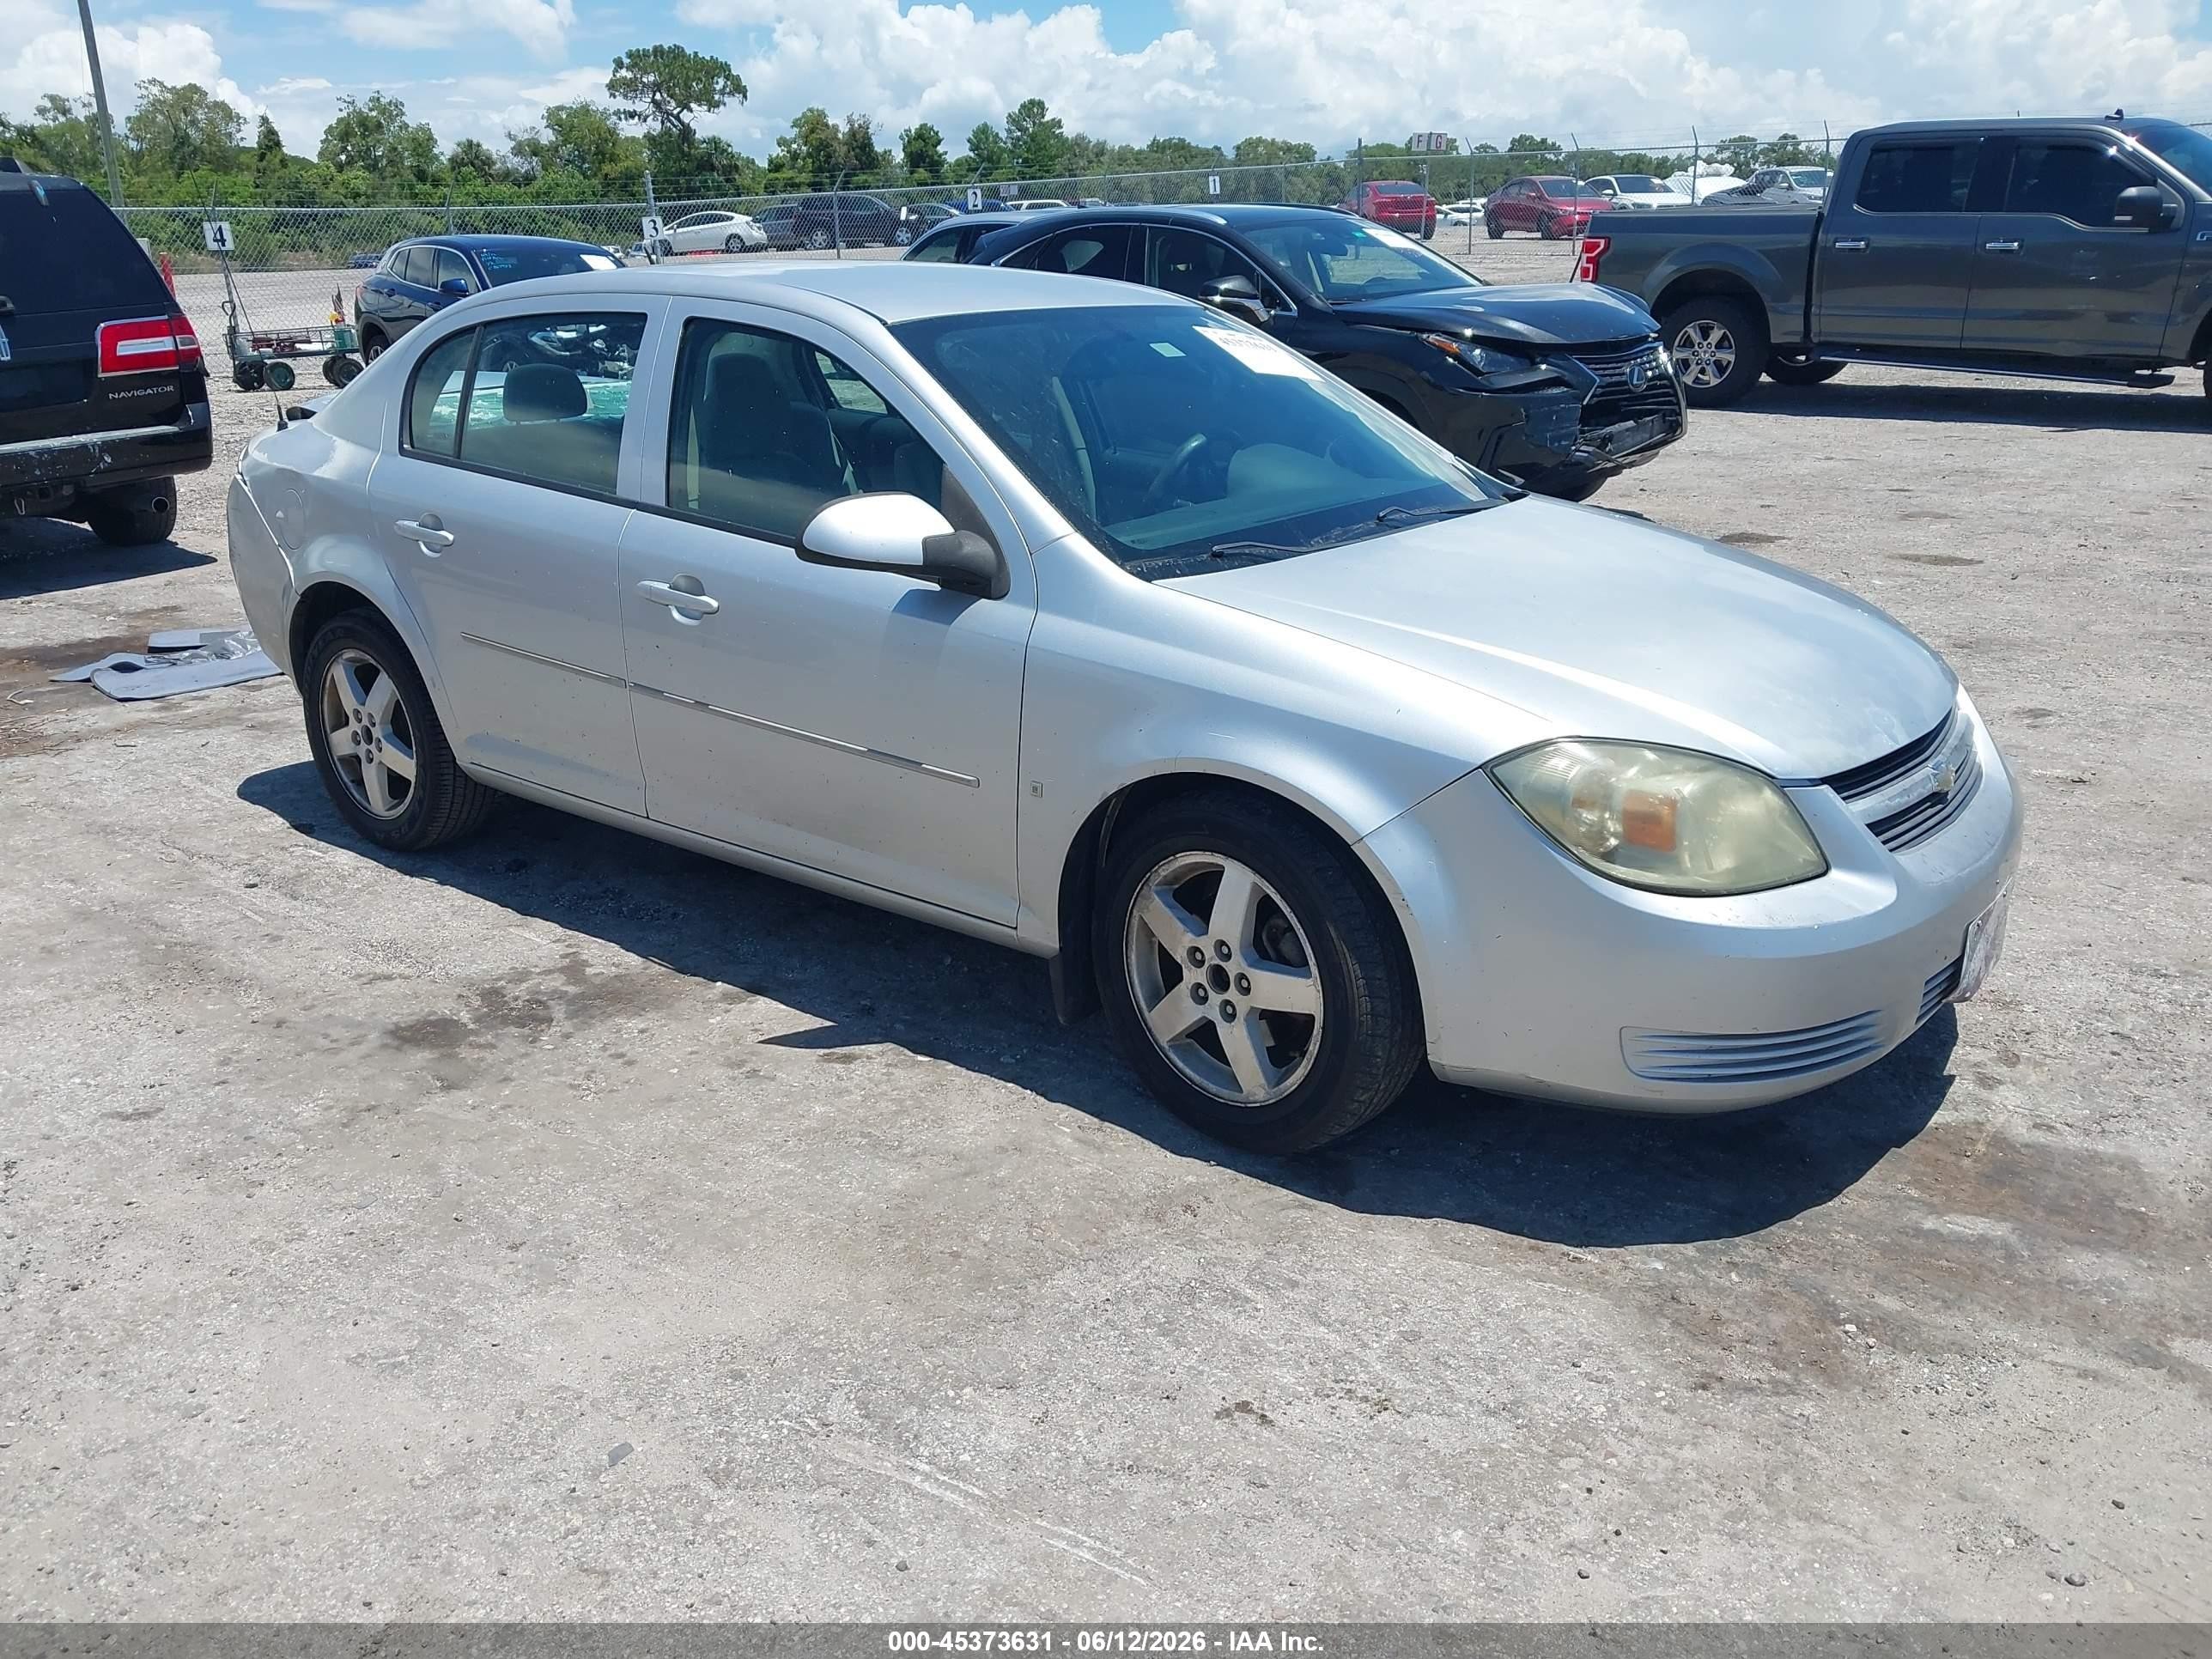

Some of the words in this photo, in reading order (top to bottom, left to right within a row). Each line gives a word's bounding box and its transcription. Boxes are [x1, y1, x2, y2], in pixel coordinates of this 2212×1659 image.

[1416, 134, 1423, 149] F
[1435, 135, 1443, 149] G
[970, 191, 980, 208] 2
[212, 224, 227, 247] 4
[647, 218, 659, 238] 3
[108, 385, 174, 400] NAVIGATOR
